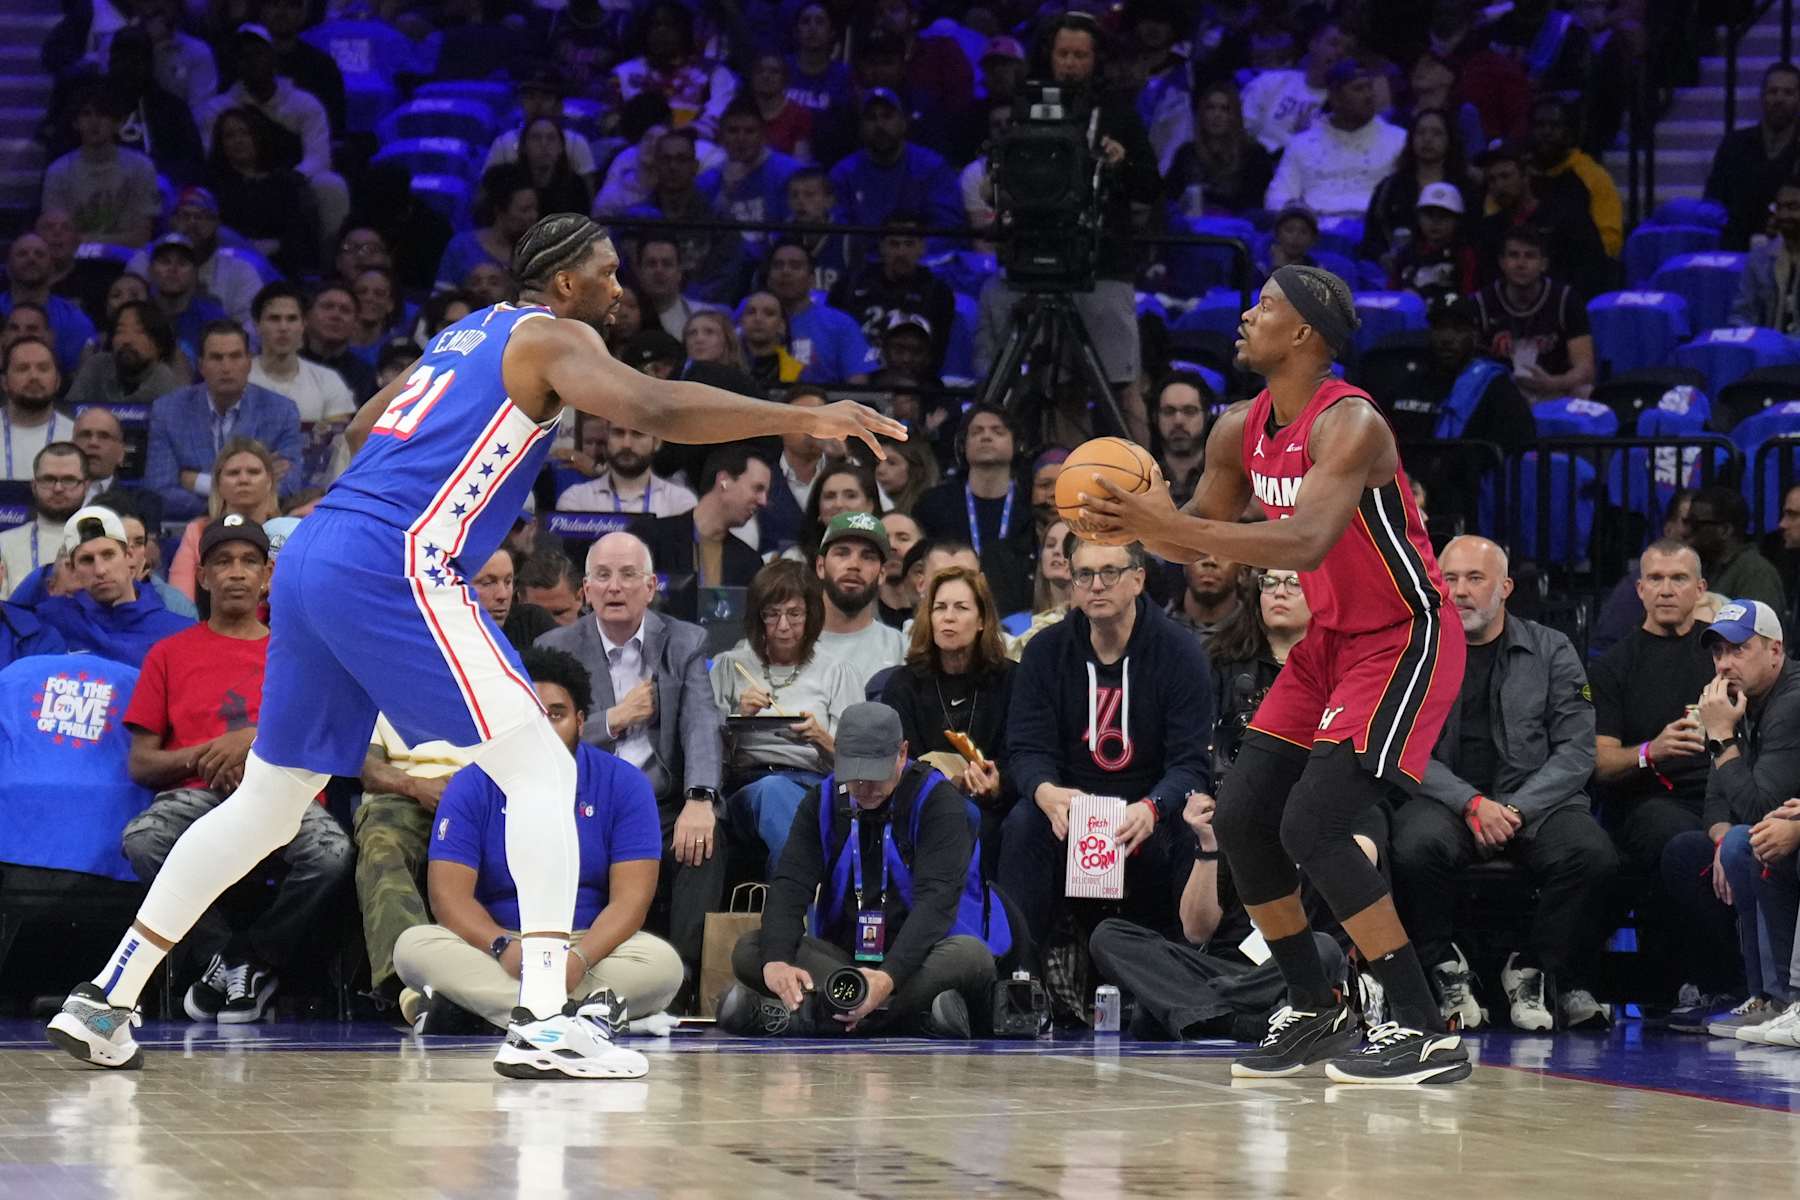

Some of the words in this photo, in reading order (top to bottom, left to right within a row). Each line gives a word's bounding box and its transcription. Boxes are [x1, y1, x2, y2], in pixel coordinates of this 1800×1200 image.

[371, 365, 456, 441] 21
[548, 515, 626, 536] Philadelphia
[46, 677, 80, 696] FOR
[80, 681, 113, 700] THE
[40, 692, 110, 727] LOVE
[37, 718, 57, 732] OF
[58, 721, 104, 740] PHILLY
[1087, 816, 1109, 832] fresh
[1079, 835, 1107, 855] POP
[1081, 850, 1116, 870] CORN
